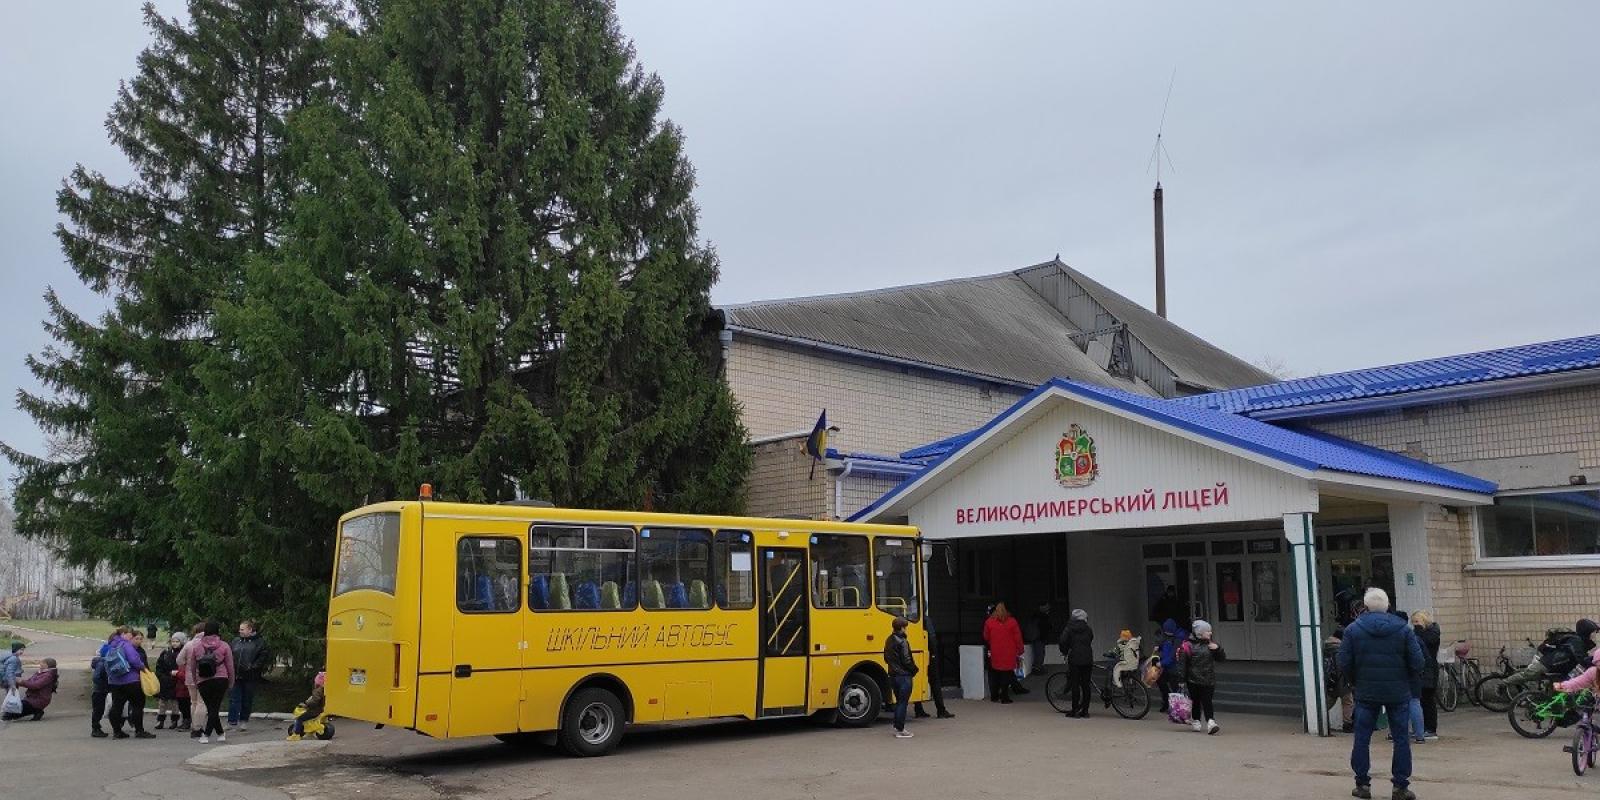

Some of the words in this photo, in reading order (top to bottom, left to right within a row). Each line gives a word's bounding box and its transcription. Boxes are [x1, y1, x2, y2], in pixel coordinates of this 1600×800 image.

[956, 488, 1156, 524] ВЕЛИКОДИМЕРСЬКИЙ
[1162, 482, 1229, 511] ЛІЦЕЙ
[546, 624, 650, 651] ШКІЛЬНИЙ
[654, 623, 738, 648] АВТОБУС
